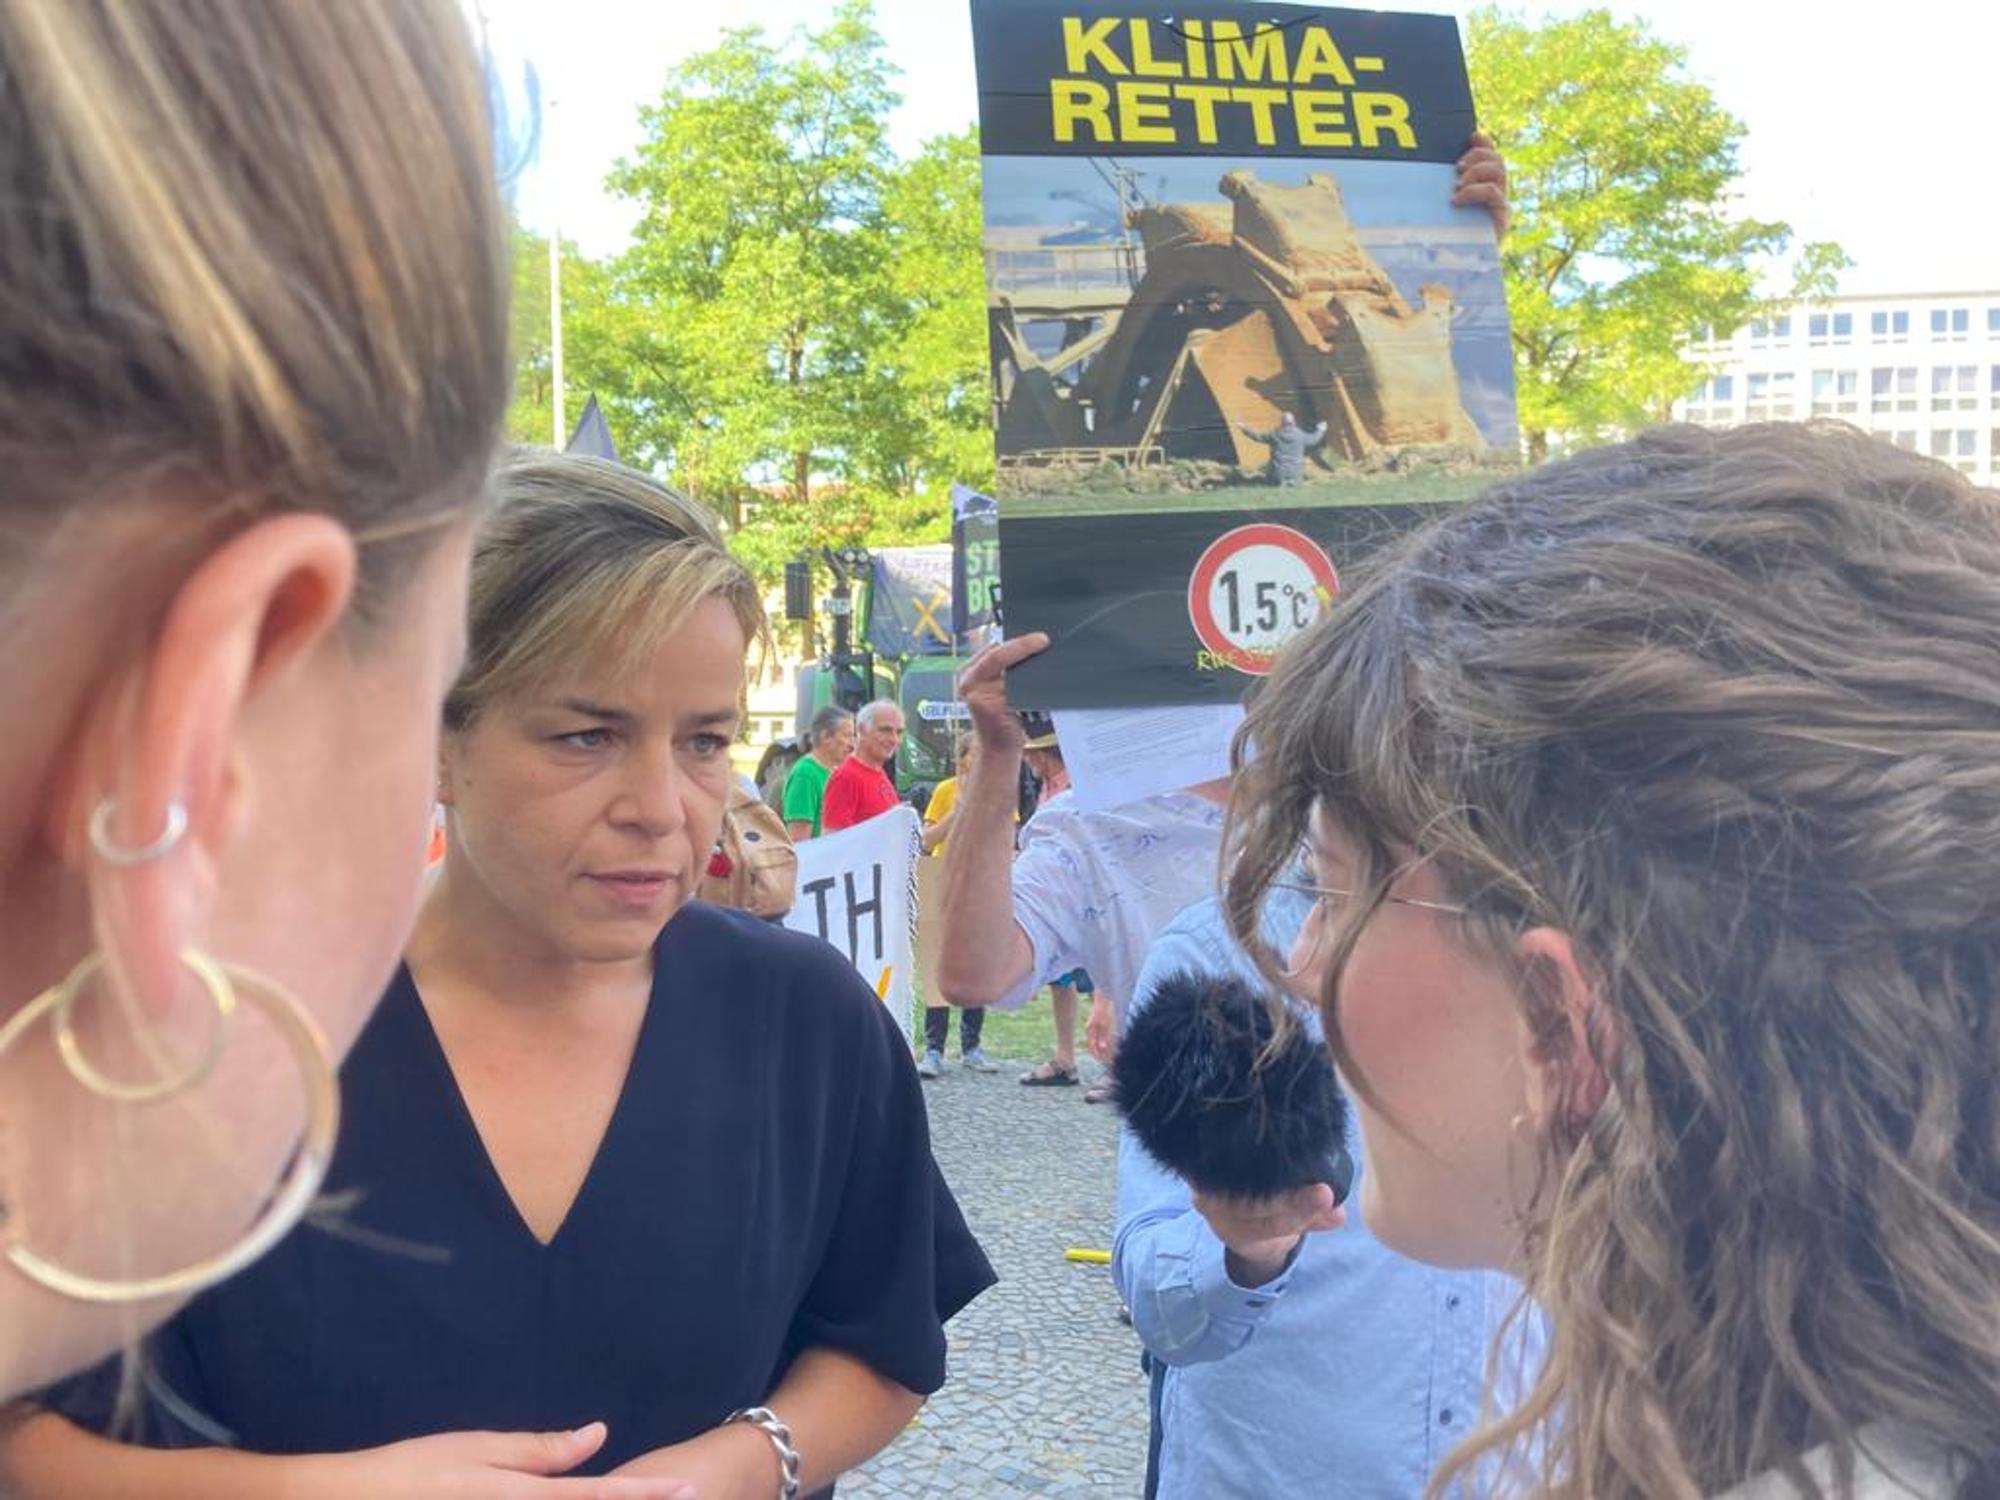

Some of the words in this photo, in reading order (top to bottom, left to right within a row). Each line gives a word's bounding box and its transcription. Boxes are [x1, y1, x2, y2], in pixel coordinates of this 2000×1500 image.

[1062, 16, 1385, 86] KLIMA-
[1050, 78, 1419, 149] RETTER
[1219, 569, 1309, 636] 1,5°C
[803, 864, 883, 969] TH
